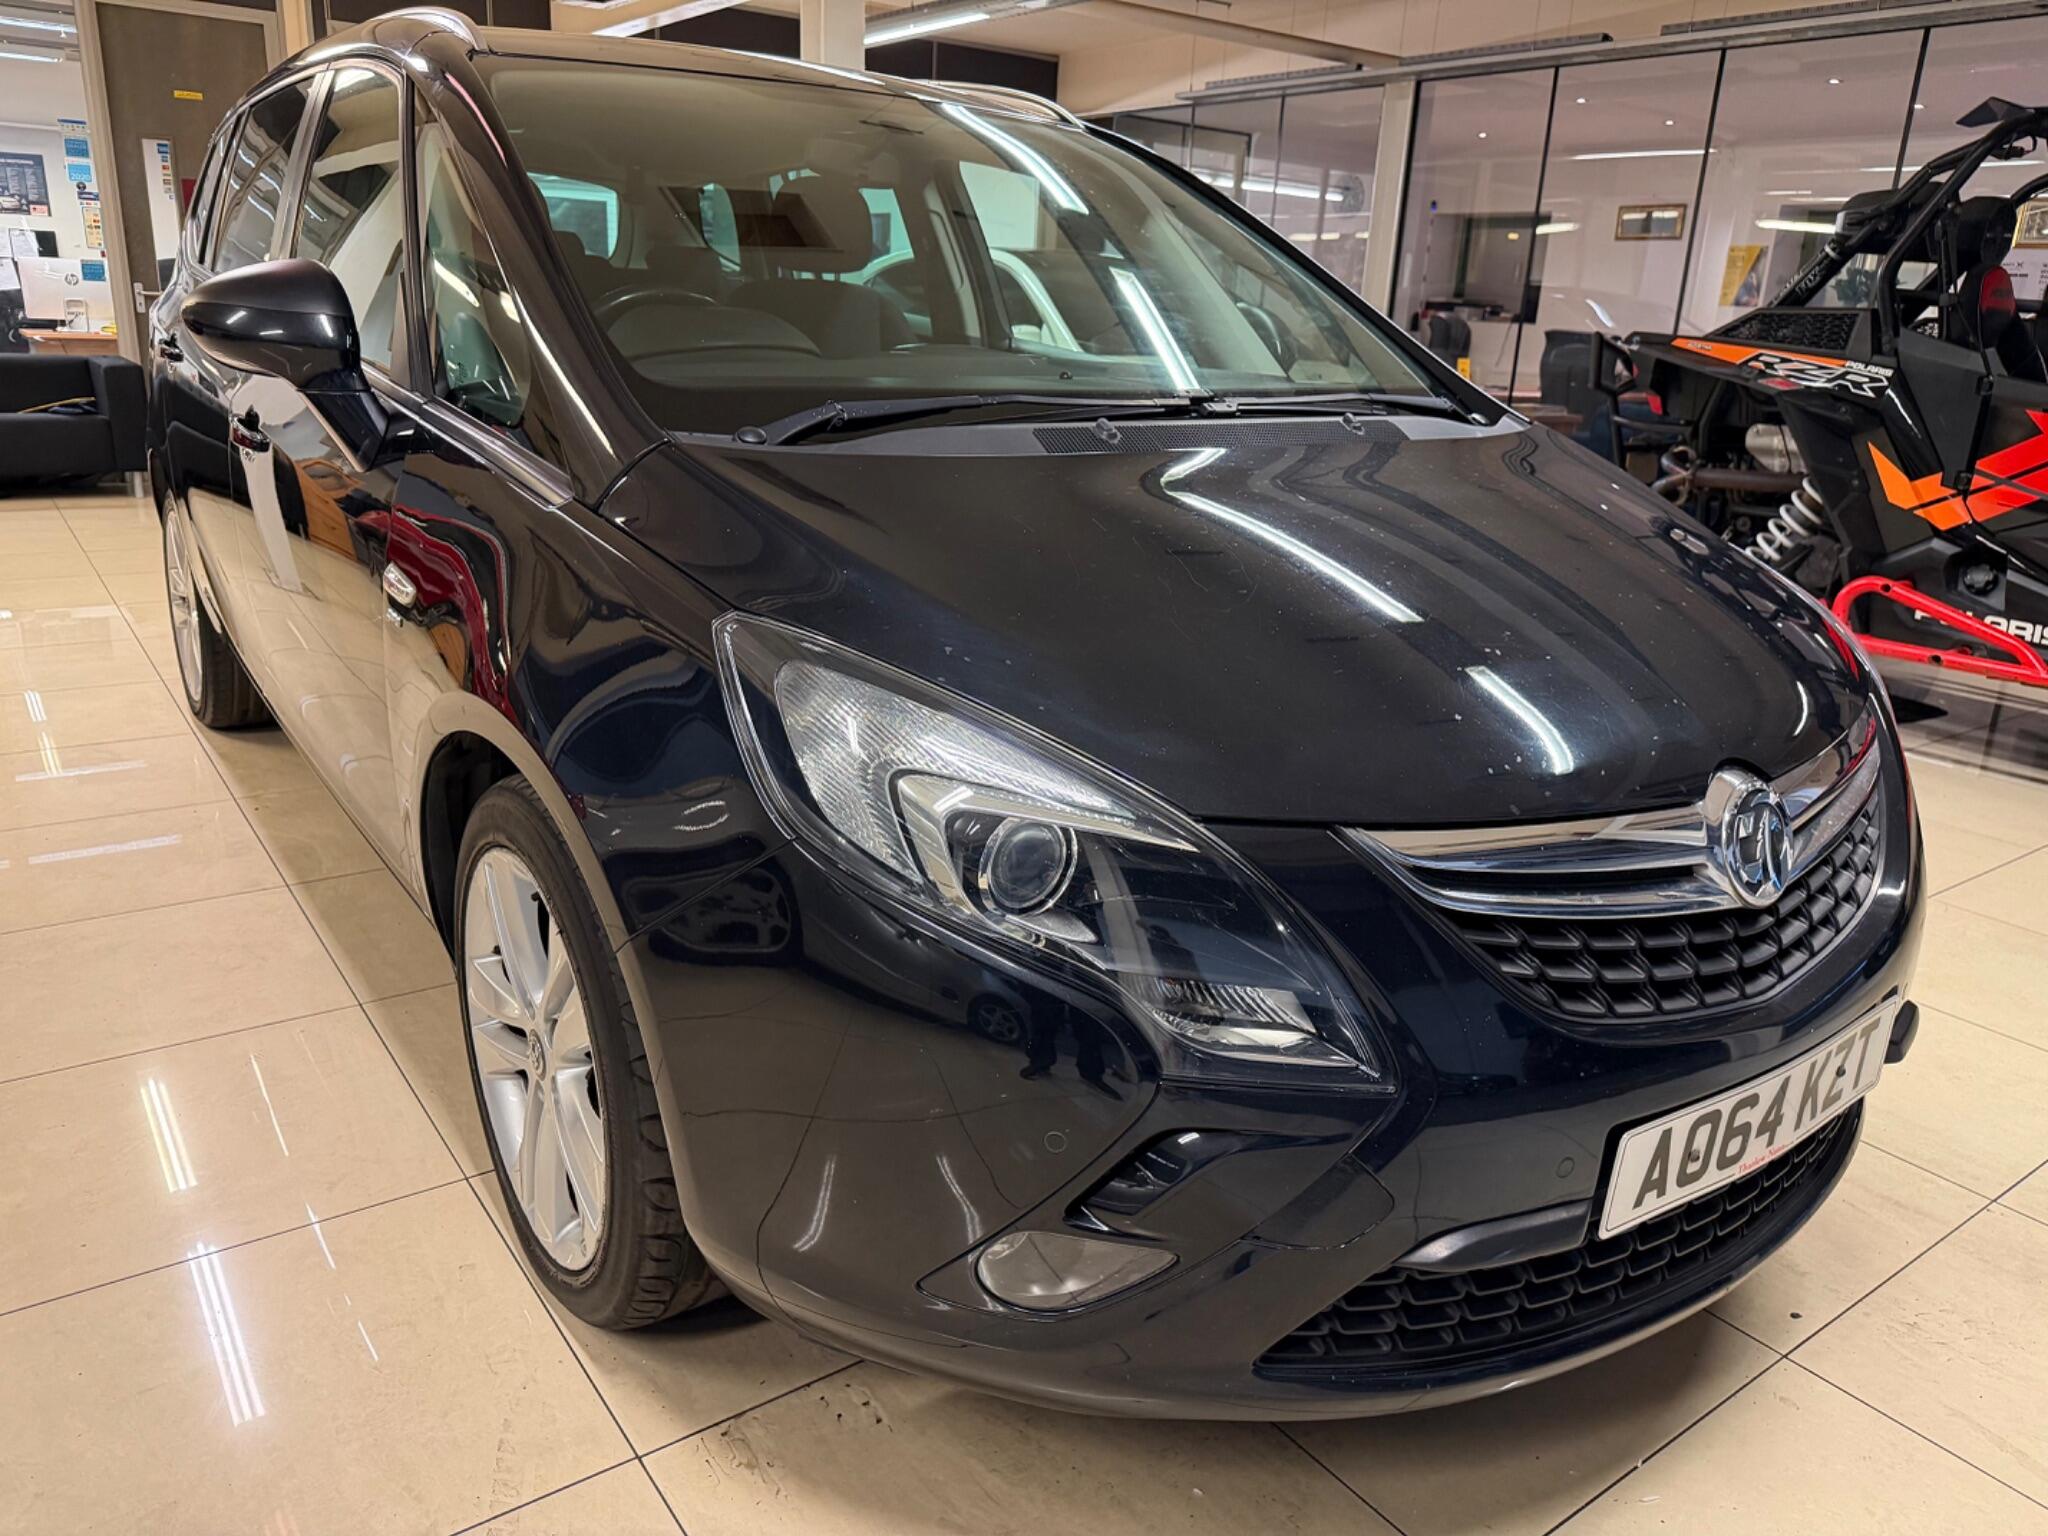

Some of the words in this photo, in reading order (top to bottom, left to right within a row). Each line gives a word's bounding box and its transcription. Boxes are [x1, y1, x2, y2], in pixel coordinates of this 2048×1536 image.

[1748, 351, 1890, 398] RZR
[1845, 360, 1894, 377] POLARIS
[1794, 1017, 1881, 1132] KZT
